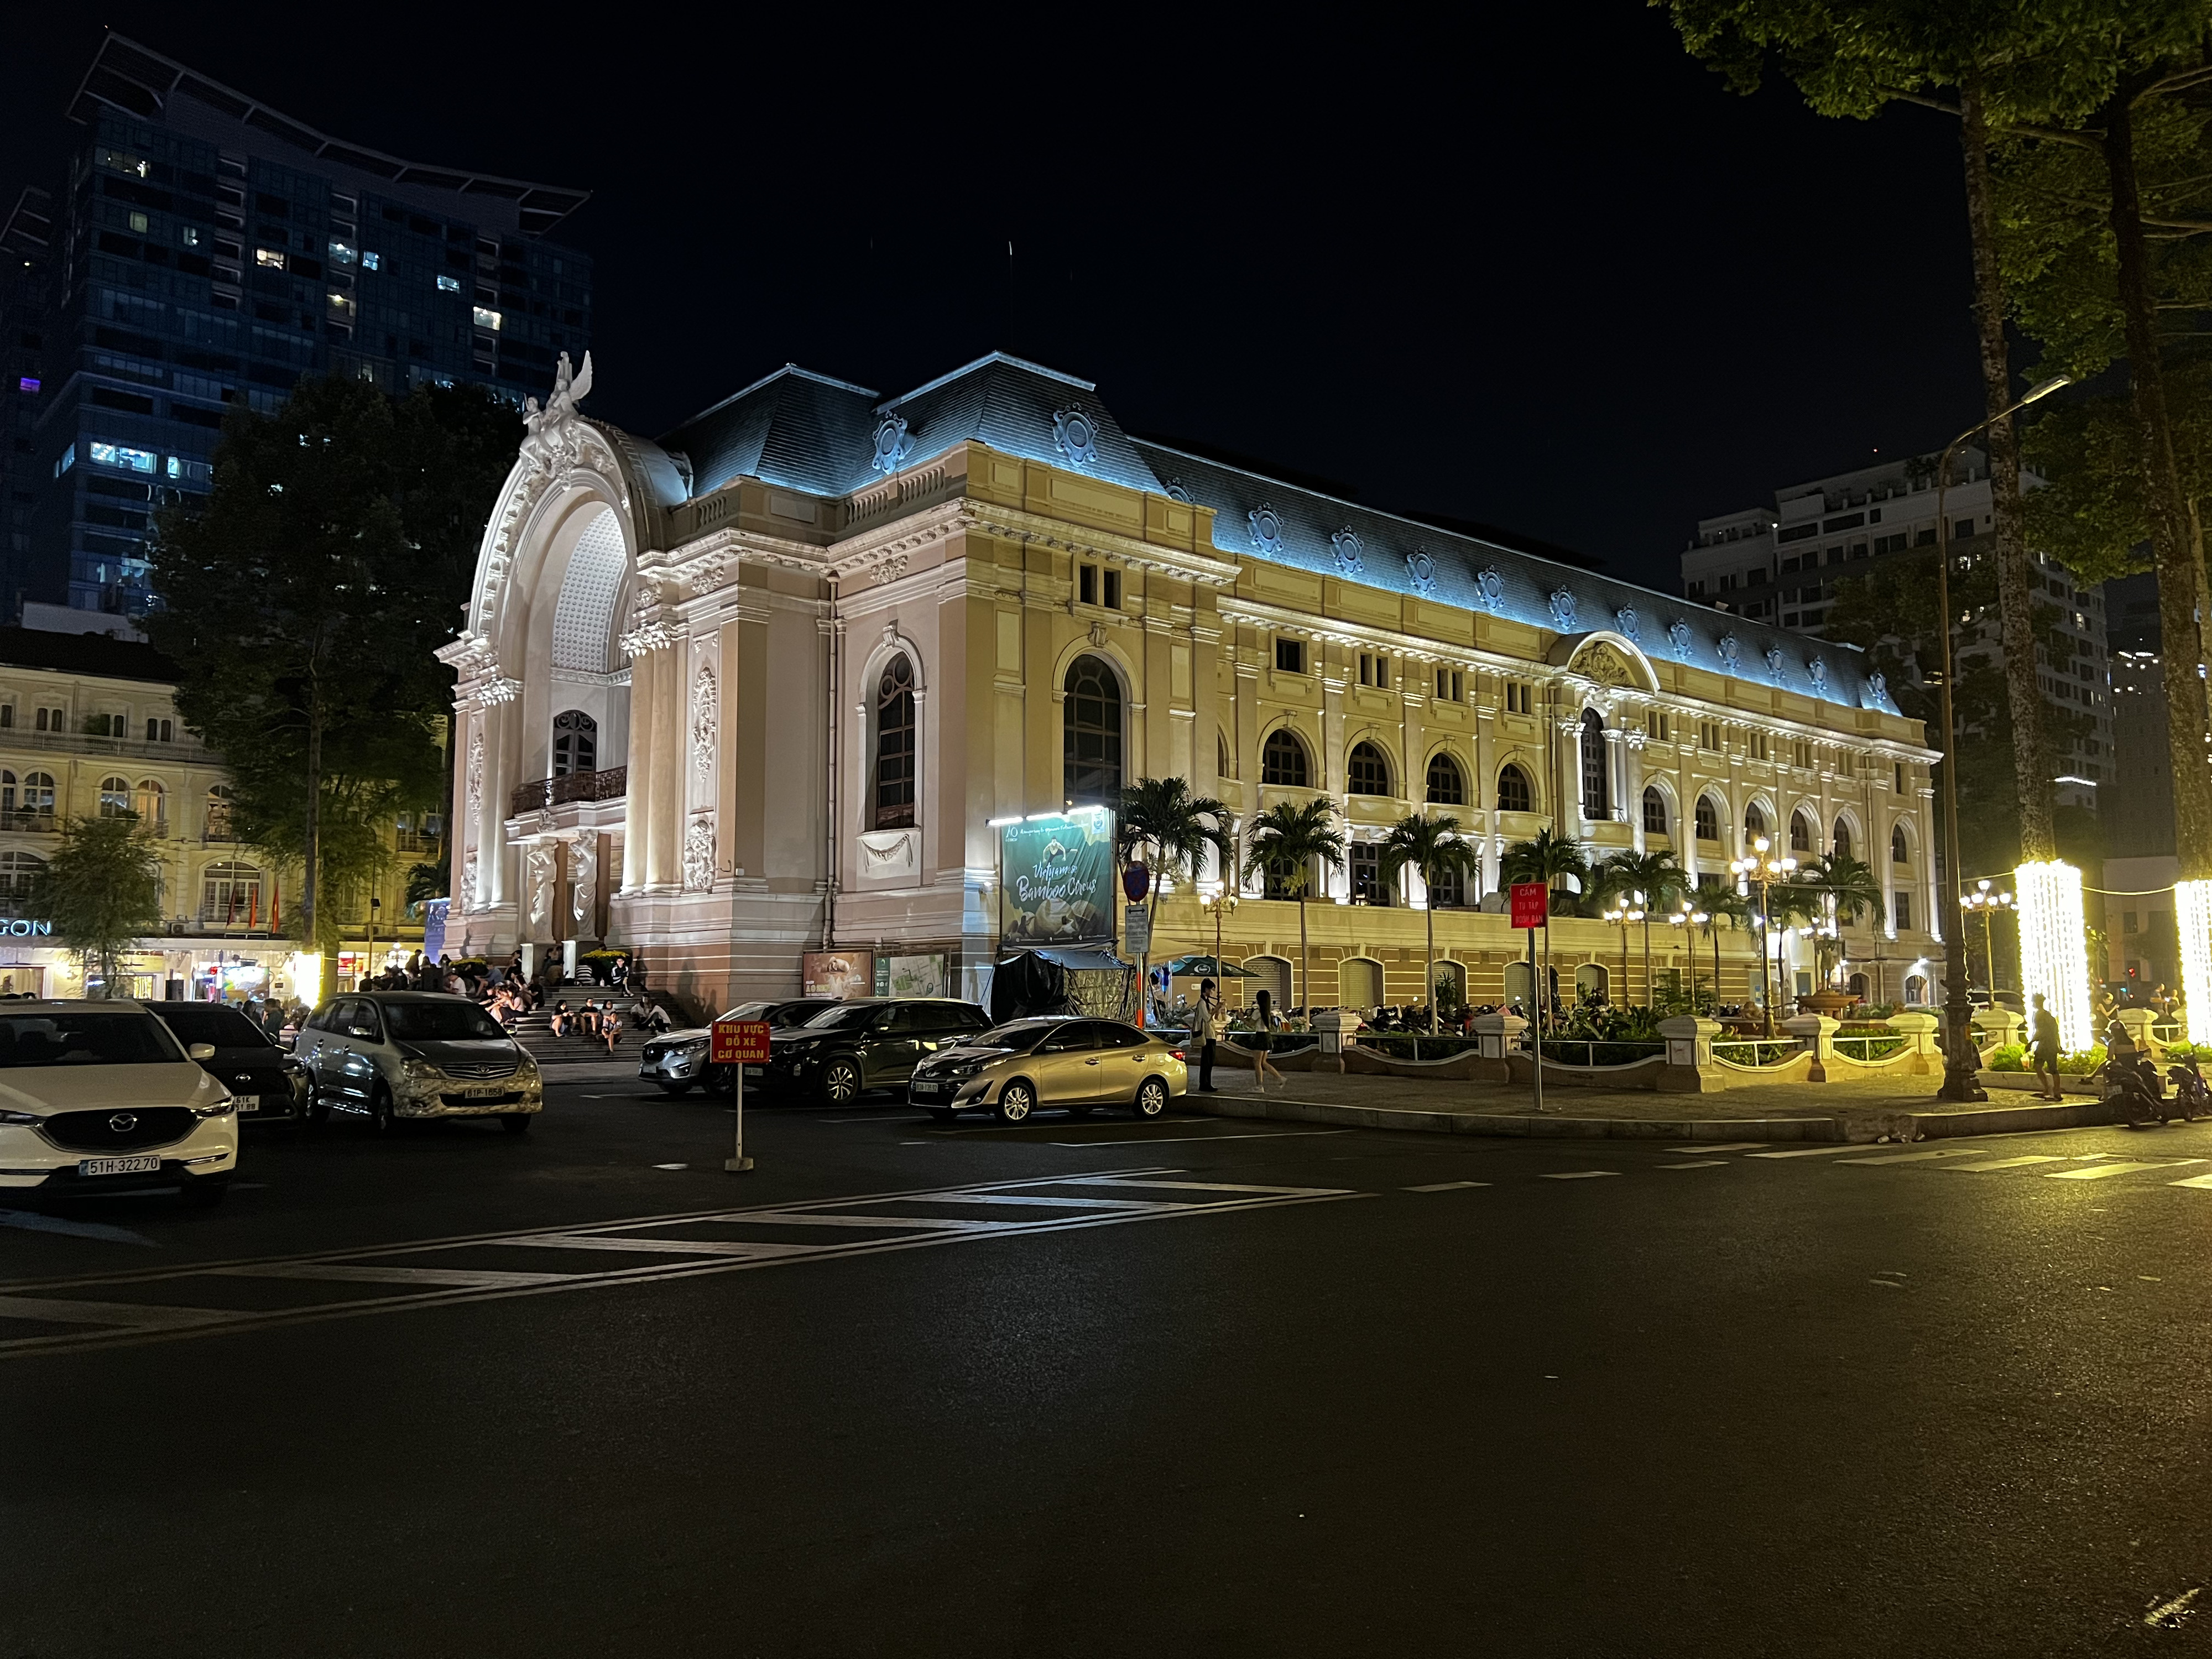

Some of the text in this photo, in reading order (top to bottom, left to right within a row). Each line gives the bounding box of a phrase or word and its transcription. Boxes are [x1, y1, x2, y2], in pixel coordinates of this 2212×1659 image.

[1032, 860, 1078, 881] Vietnamese
[1016, 875, 1097, 902] Bamboo Circus
[718, 1024, 764, 1035] KHU VỰC
[743, 1037, 756, 1046] XE
[718, 1050, 764, 1059] CƠ QUAN
